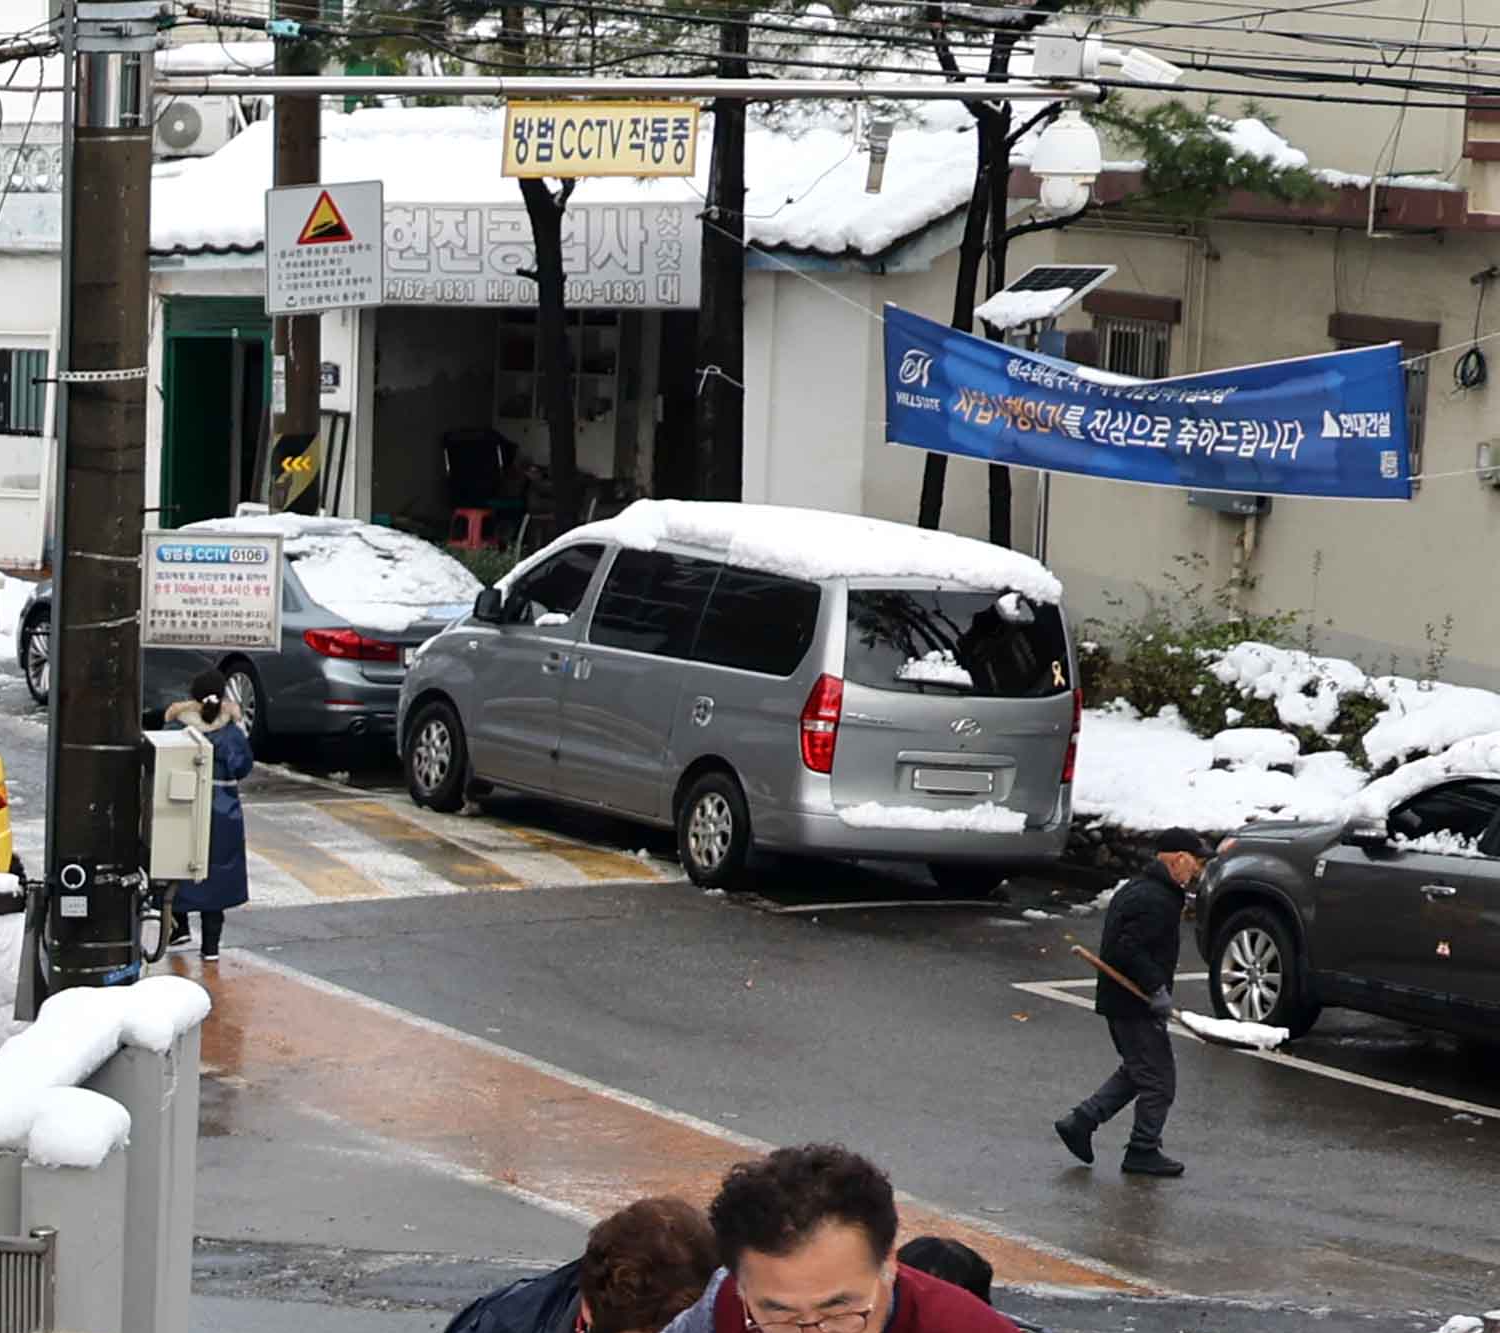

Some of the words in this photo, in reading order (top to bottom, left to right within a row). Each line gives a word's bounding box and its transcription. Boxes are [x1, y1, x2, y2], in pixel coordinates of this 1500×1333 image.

[513, 117, 555, 165] 방범
[560, 118, 623, 160] CCTV
[629, 117, 690, 165] 작동중
[1087, 408, 1172, 448] 진심으로
[1176, 416, 1306, 460] 축하드립니다
[1338, 411, 1392, 438] 현대건설
[195, 548, 228, 561] CCTV
[231, 550, 263, 561] 0106
